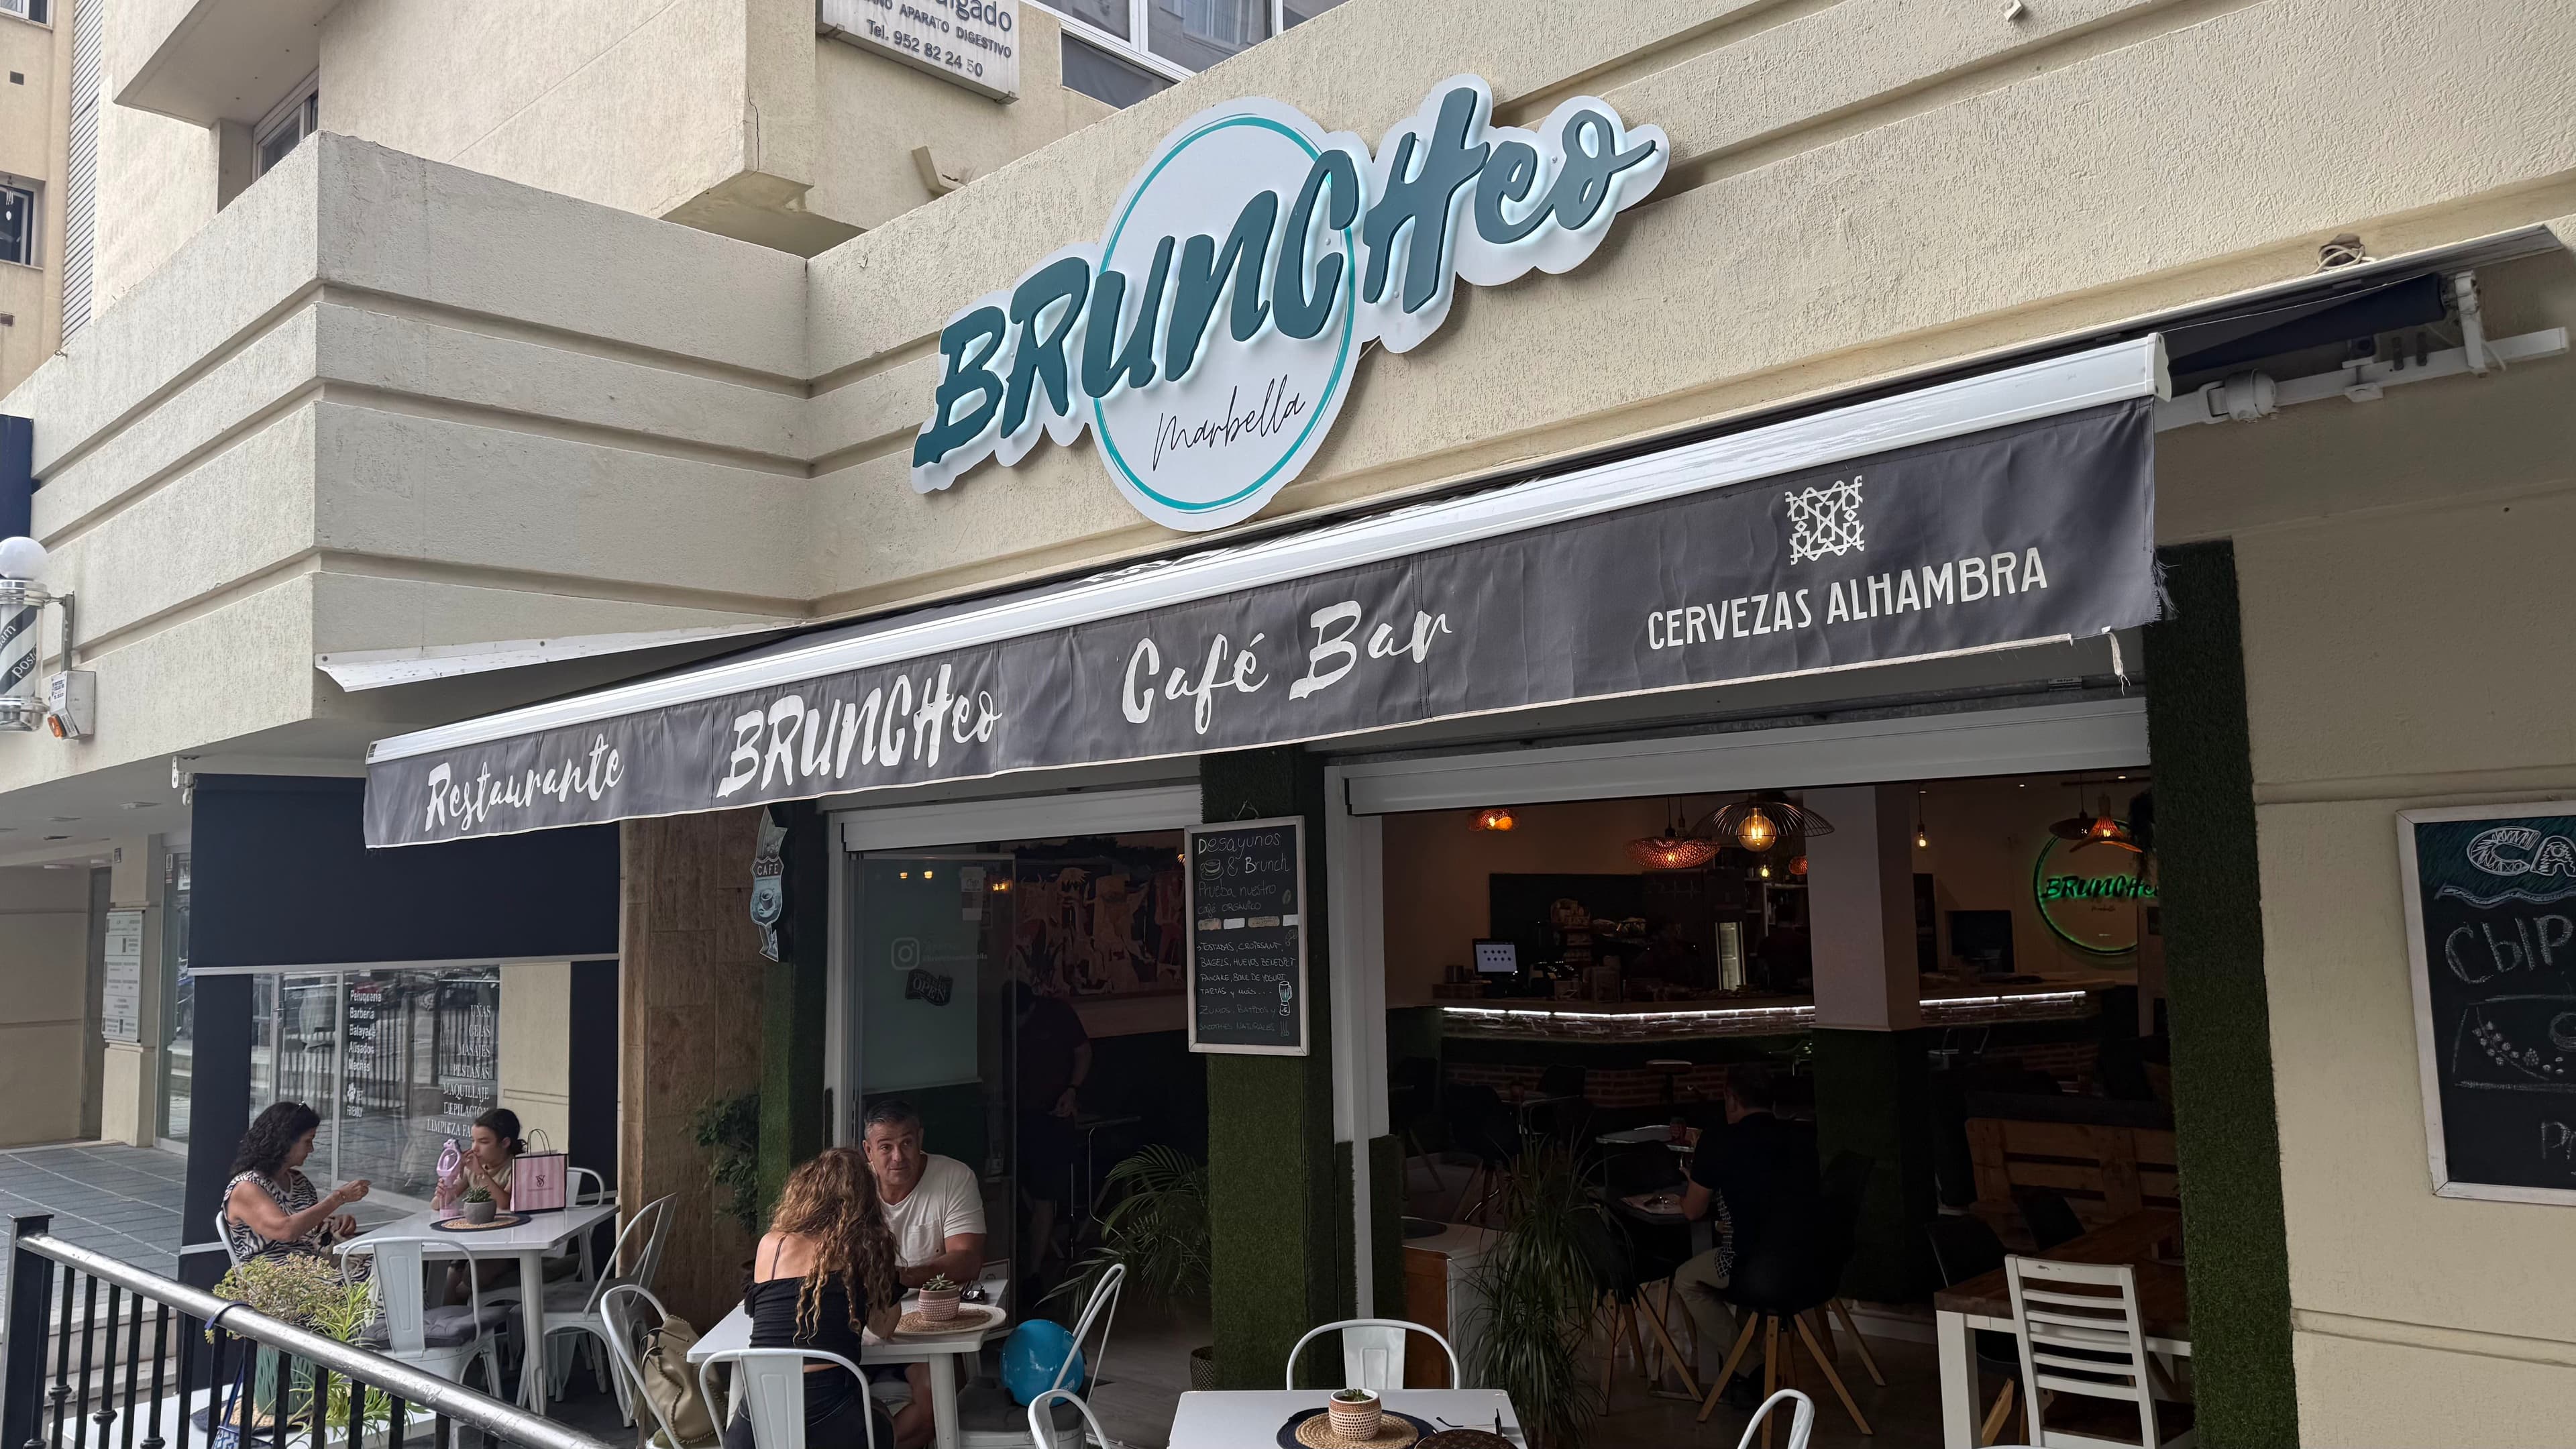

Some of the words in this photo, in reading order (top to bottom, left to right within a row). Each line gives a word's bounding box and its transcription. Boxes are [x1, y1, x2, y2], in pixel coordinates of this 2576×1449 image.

[899, 3, 950, 33] APARATO
[955, 26, 1012, 58] DIGESTIVO
[866, 19, 889, 40] Tel.
[893, 30, 920, 52] 952
[924, 42, 941, 61] 82
[945, 51, 963, 68] 24
[967, 59, 983, 77] 50
[1152, 377, 1307, 472] Marbella
[1647, 589, 1813, 651] CERVEZAS
[1826, 547, 2048, 625] ALHAMBRA
[424, 734, 625, 832] Restaurante
[1122, 632, 1269, 735] Café
[1289, 600, 1453, 701] Bar
[1198, 833, 1281, 859] Desayunos
[757, 863, 779, 876] CAFE
[1227, 857, 1239, 877] &
[1245, 853, 1290, 874] Brunch
[1199, 878, 1237, 898] Prueba
[1240, 879, 1277, 897] nuestro
[1197, 903, 1217, 918] café
[913, 976, 946, 1002] OPEN
[471, 1004, 490, 1018] UÑAS
[443, 1083, 490, 1103] MAQUILLAJE
[427, 1118, 461, 1137] LIMPIEZA
